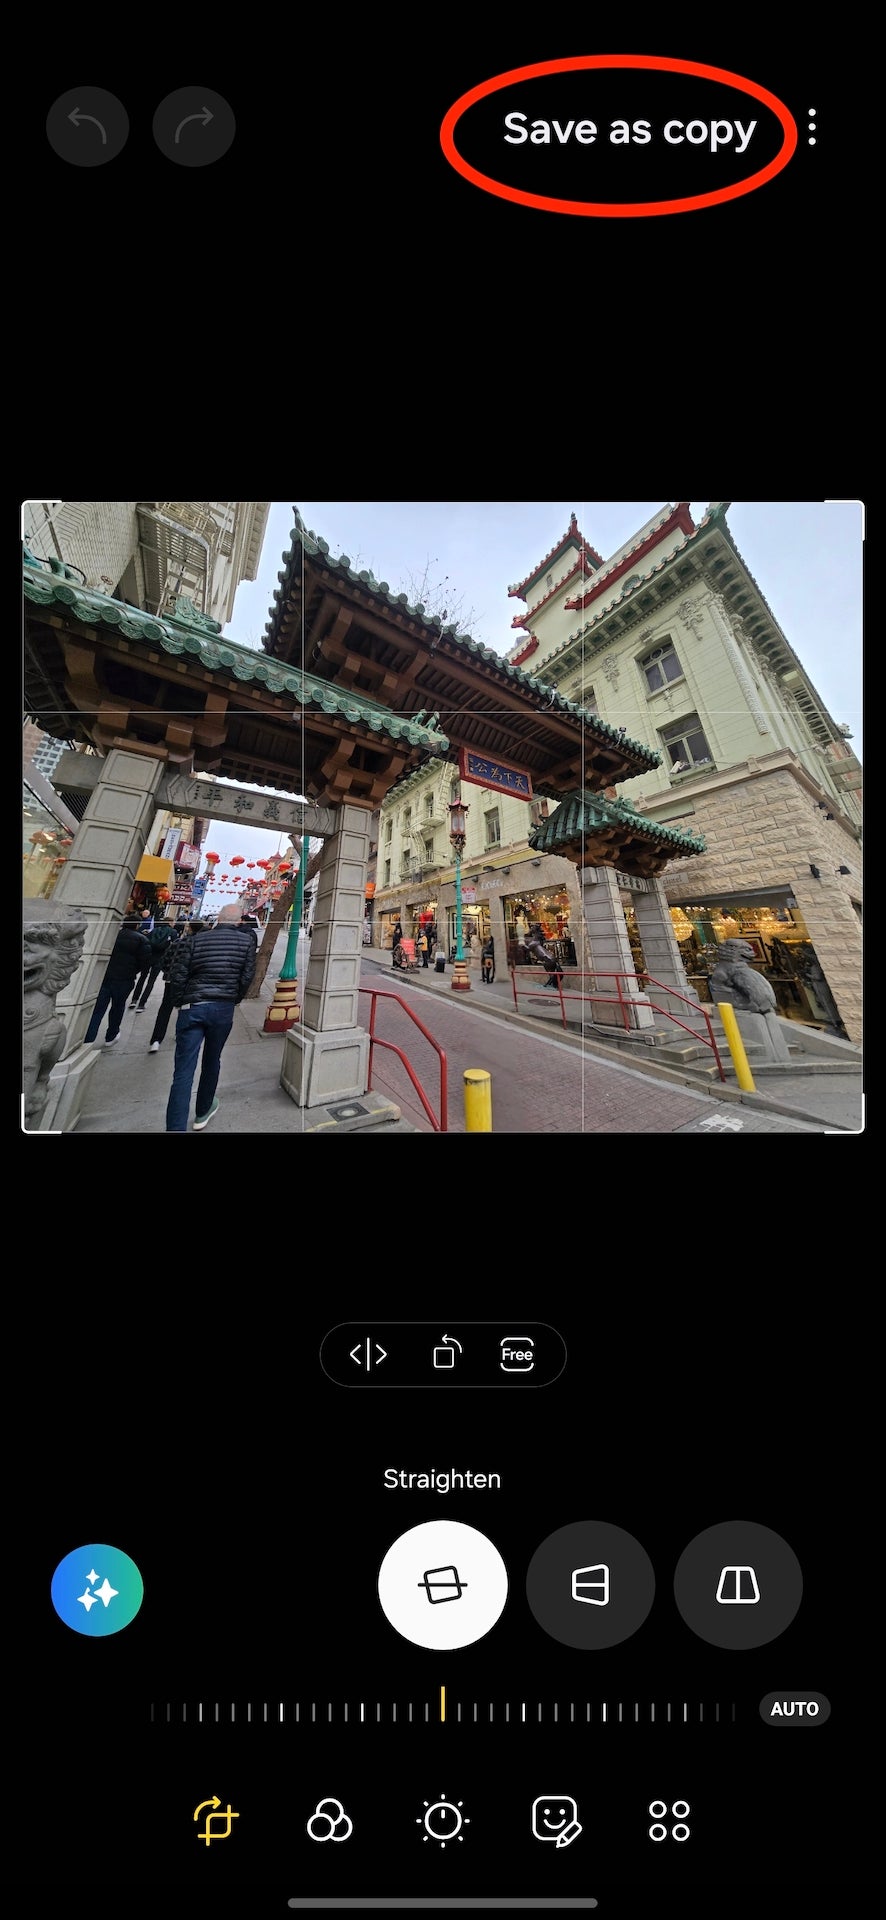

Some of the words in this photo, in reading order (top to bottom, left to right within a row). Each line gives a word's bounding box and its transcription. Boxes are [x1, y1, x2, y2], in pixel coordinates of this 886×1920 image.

[504, 112, 597, 144] Save
[610, 120, 651, 144] as
[664, 120, 757, 152] copy
[503, 1348, 533, 1360] Free
[384, 1469, 500, 1493] Straighten
[771, 1702, 818, 1716] AUTO
